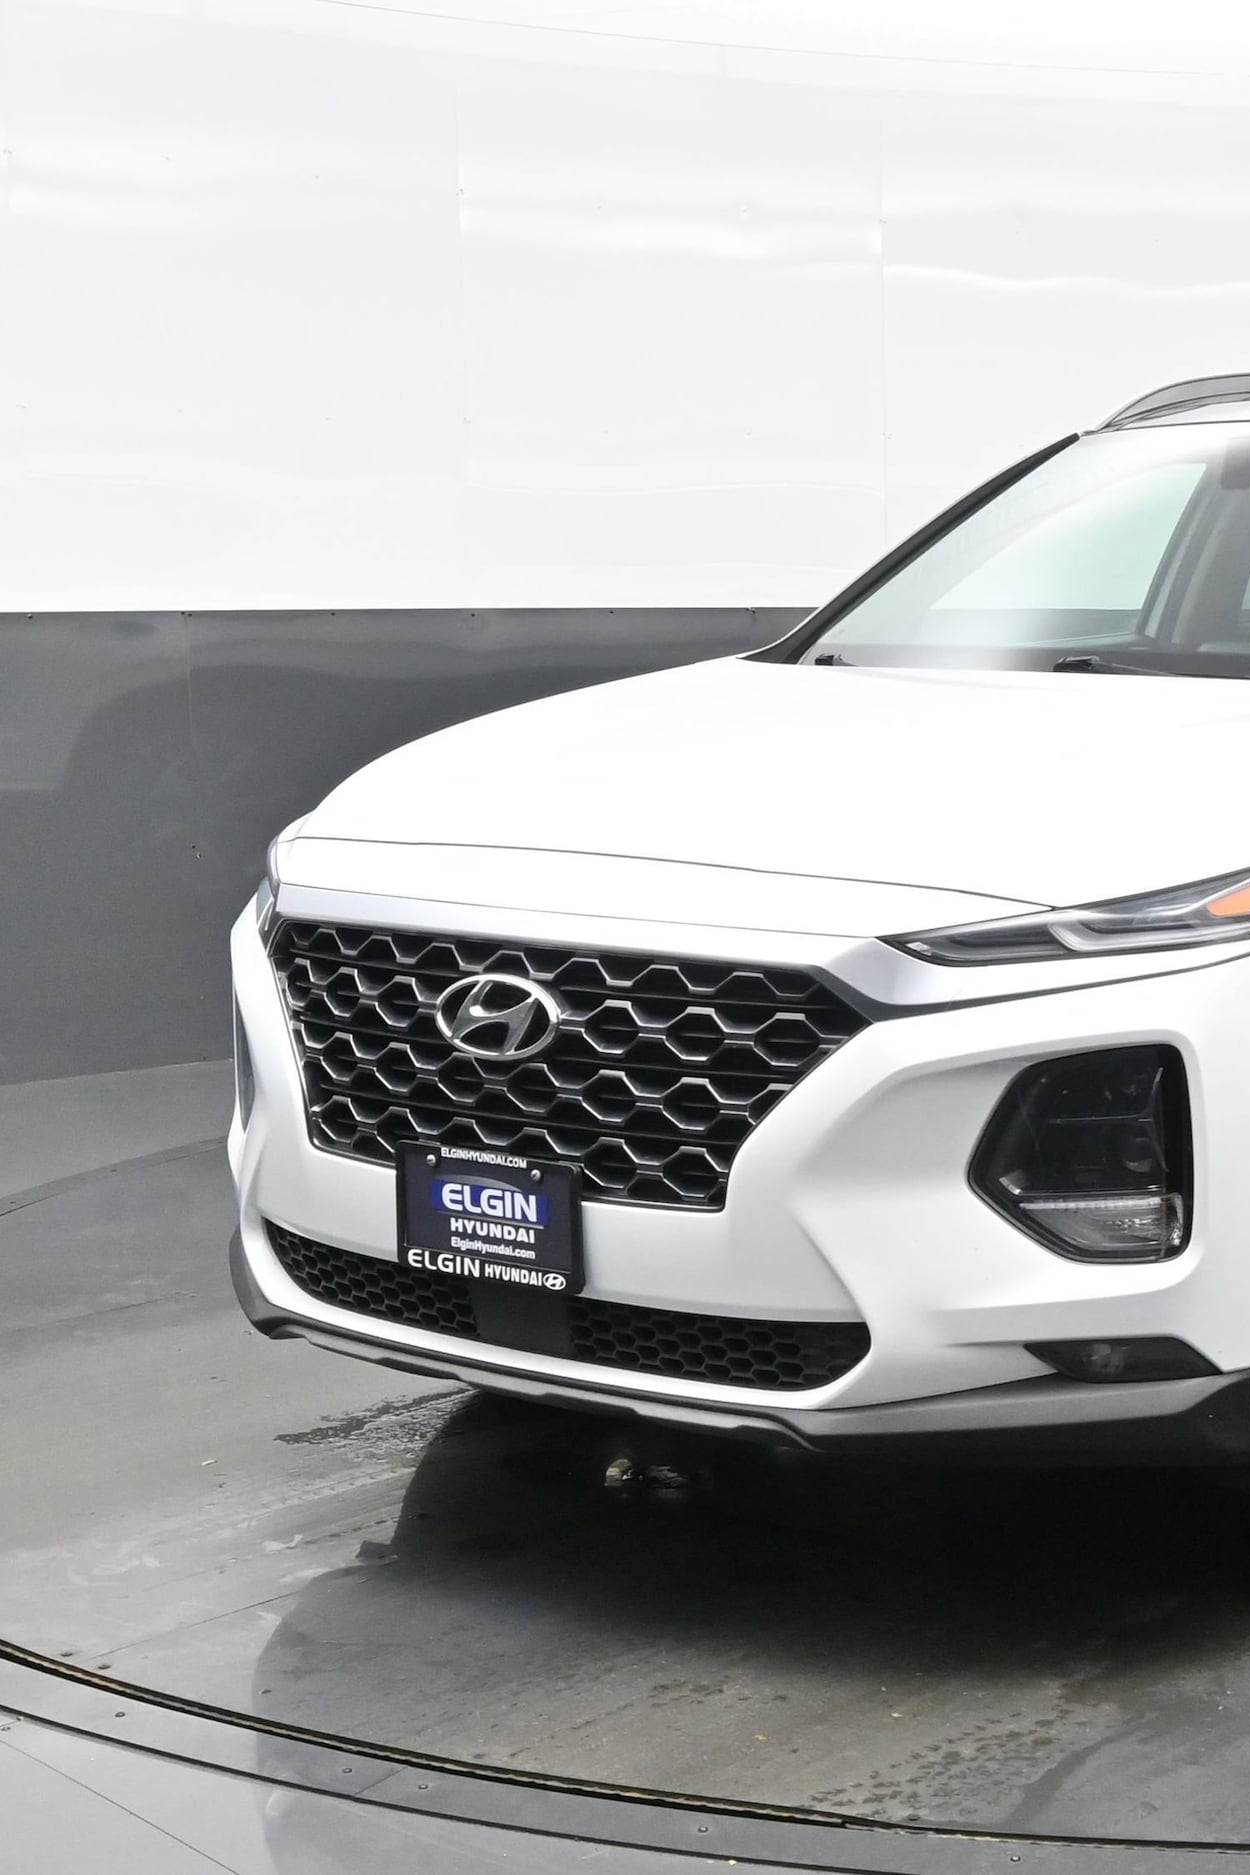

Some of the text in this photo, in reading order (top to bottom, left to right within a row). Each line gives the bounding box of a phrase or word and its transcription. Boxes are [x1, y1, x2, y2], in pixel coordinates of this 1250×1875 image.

[441, 1147, 527, 1169] ELGINHYUNDAI.COM
[441, 1182, 538, 1223] ELGIN
[450, 1217, 535, 1244] HYUNDAI
[450, 1236, 536, 1260] ElginHyundai.com
[407, 1249, 543, 1286] ELGIN HYUNDAI
